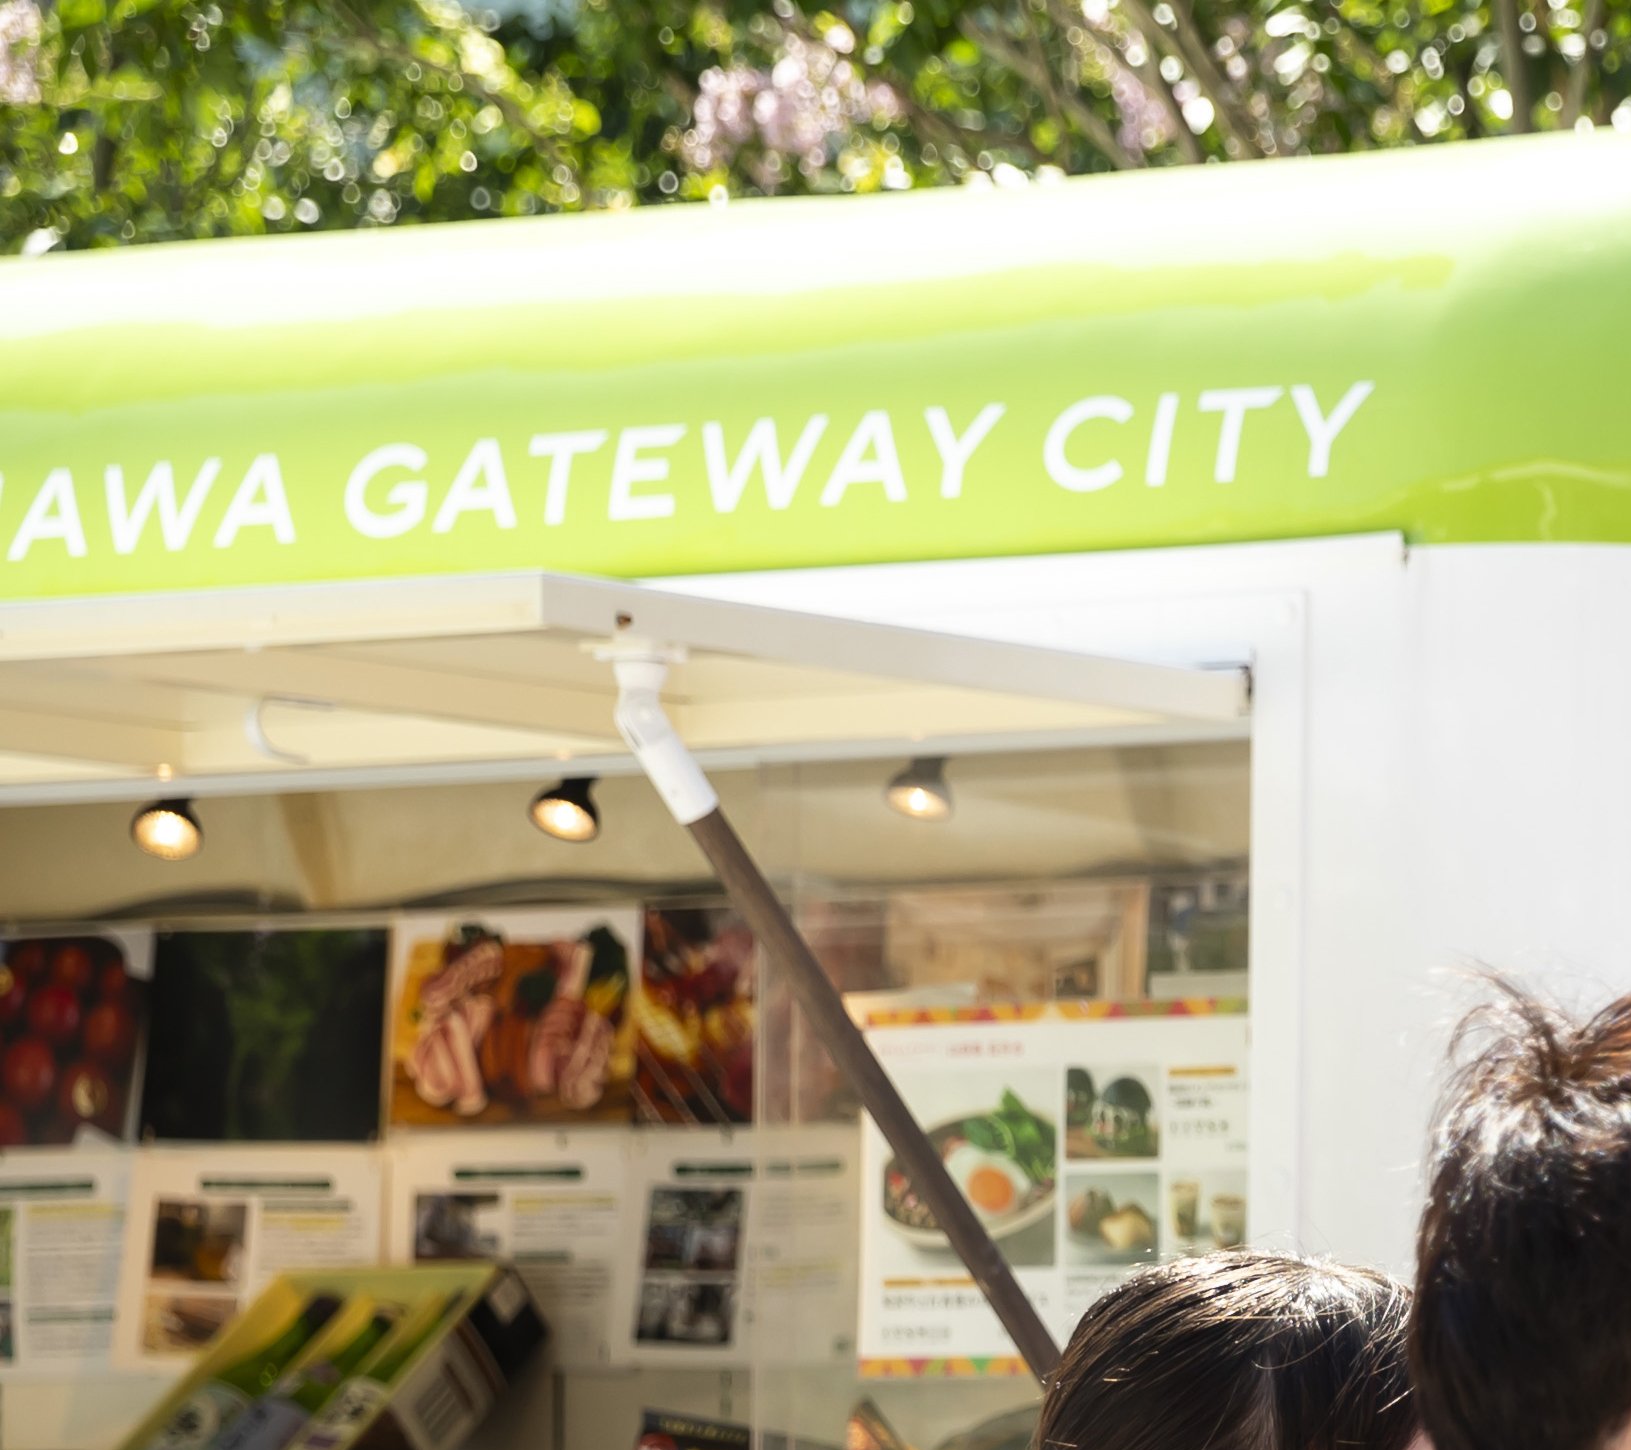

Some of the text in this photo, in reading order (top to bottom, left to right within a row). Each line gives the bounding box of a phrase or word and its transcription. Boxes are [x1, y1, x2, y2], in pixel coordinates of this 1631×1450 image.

[0, 380, 1374, 562] AWA GATEWAY CITY
